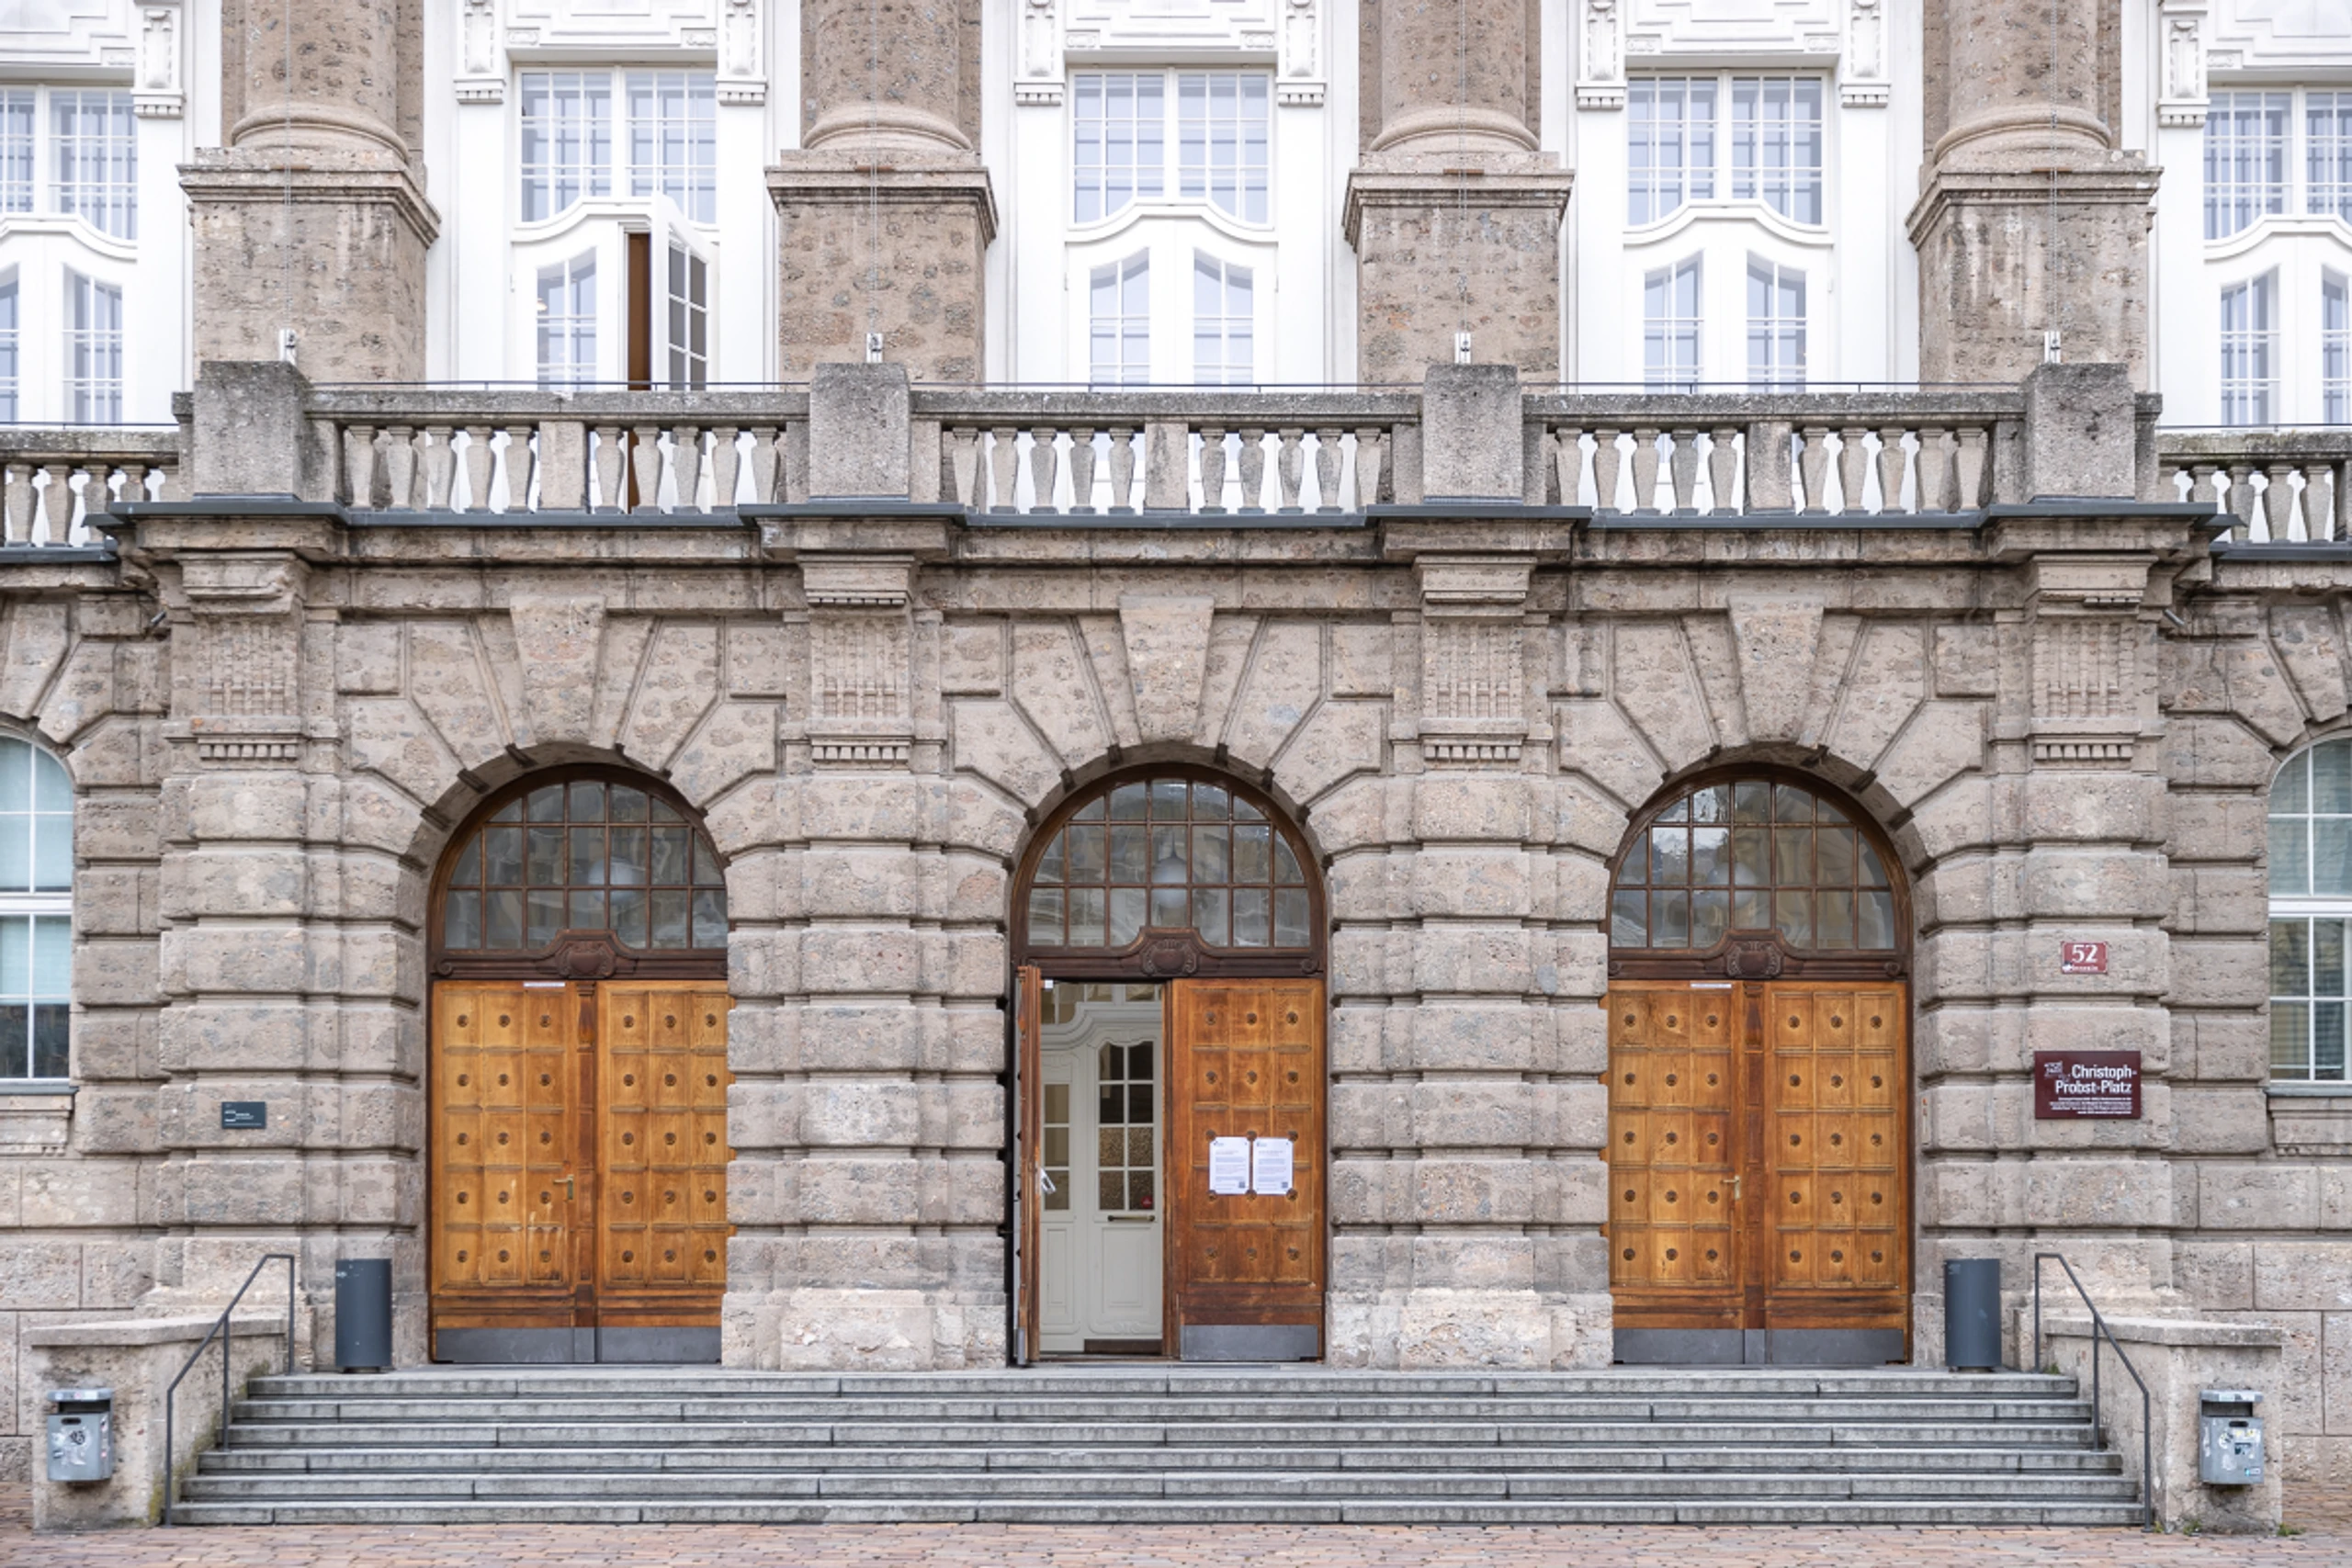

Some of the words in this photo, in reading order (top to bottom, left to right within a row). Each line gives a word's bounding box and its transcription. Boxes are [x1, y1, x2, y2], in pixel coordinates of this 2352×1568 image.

[2072, 944, 2098, 963] 52
[2072, 1064, 2137, 1080] Christoph-
[2055, 1080, 2132, 1094] Probst-Platz
